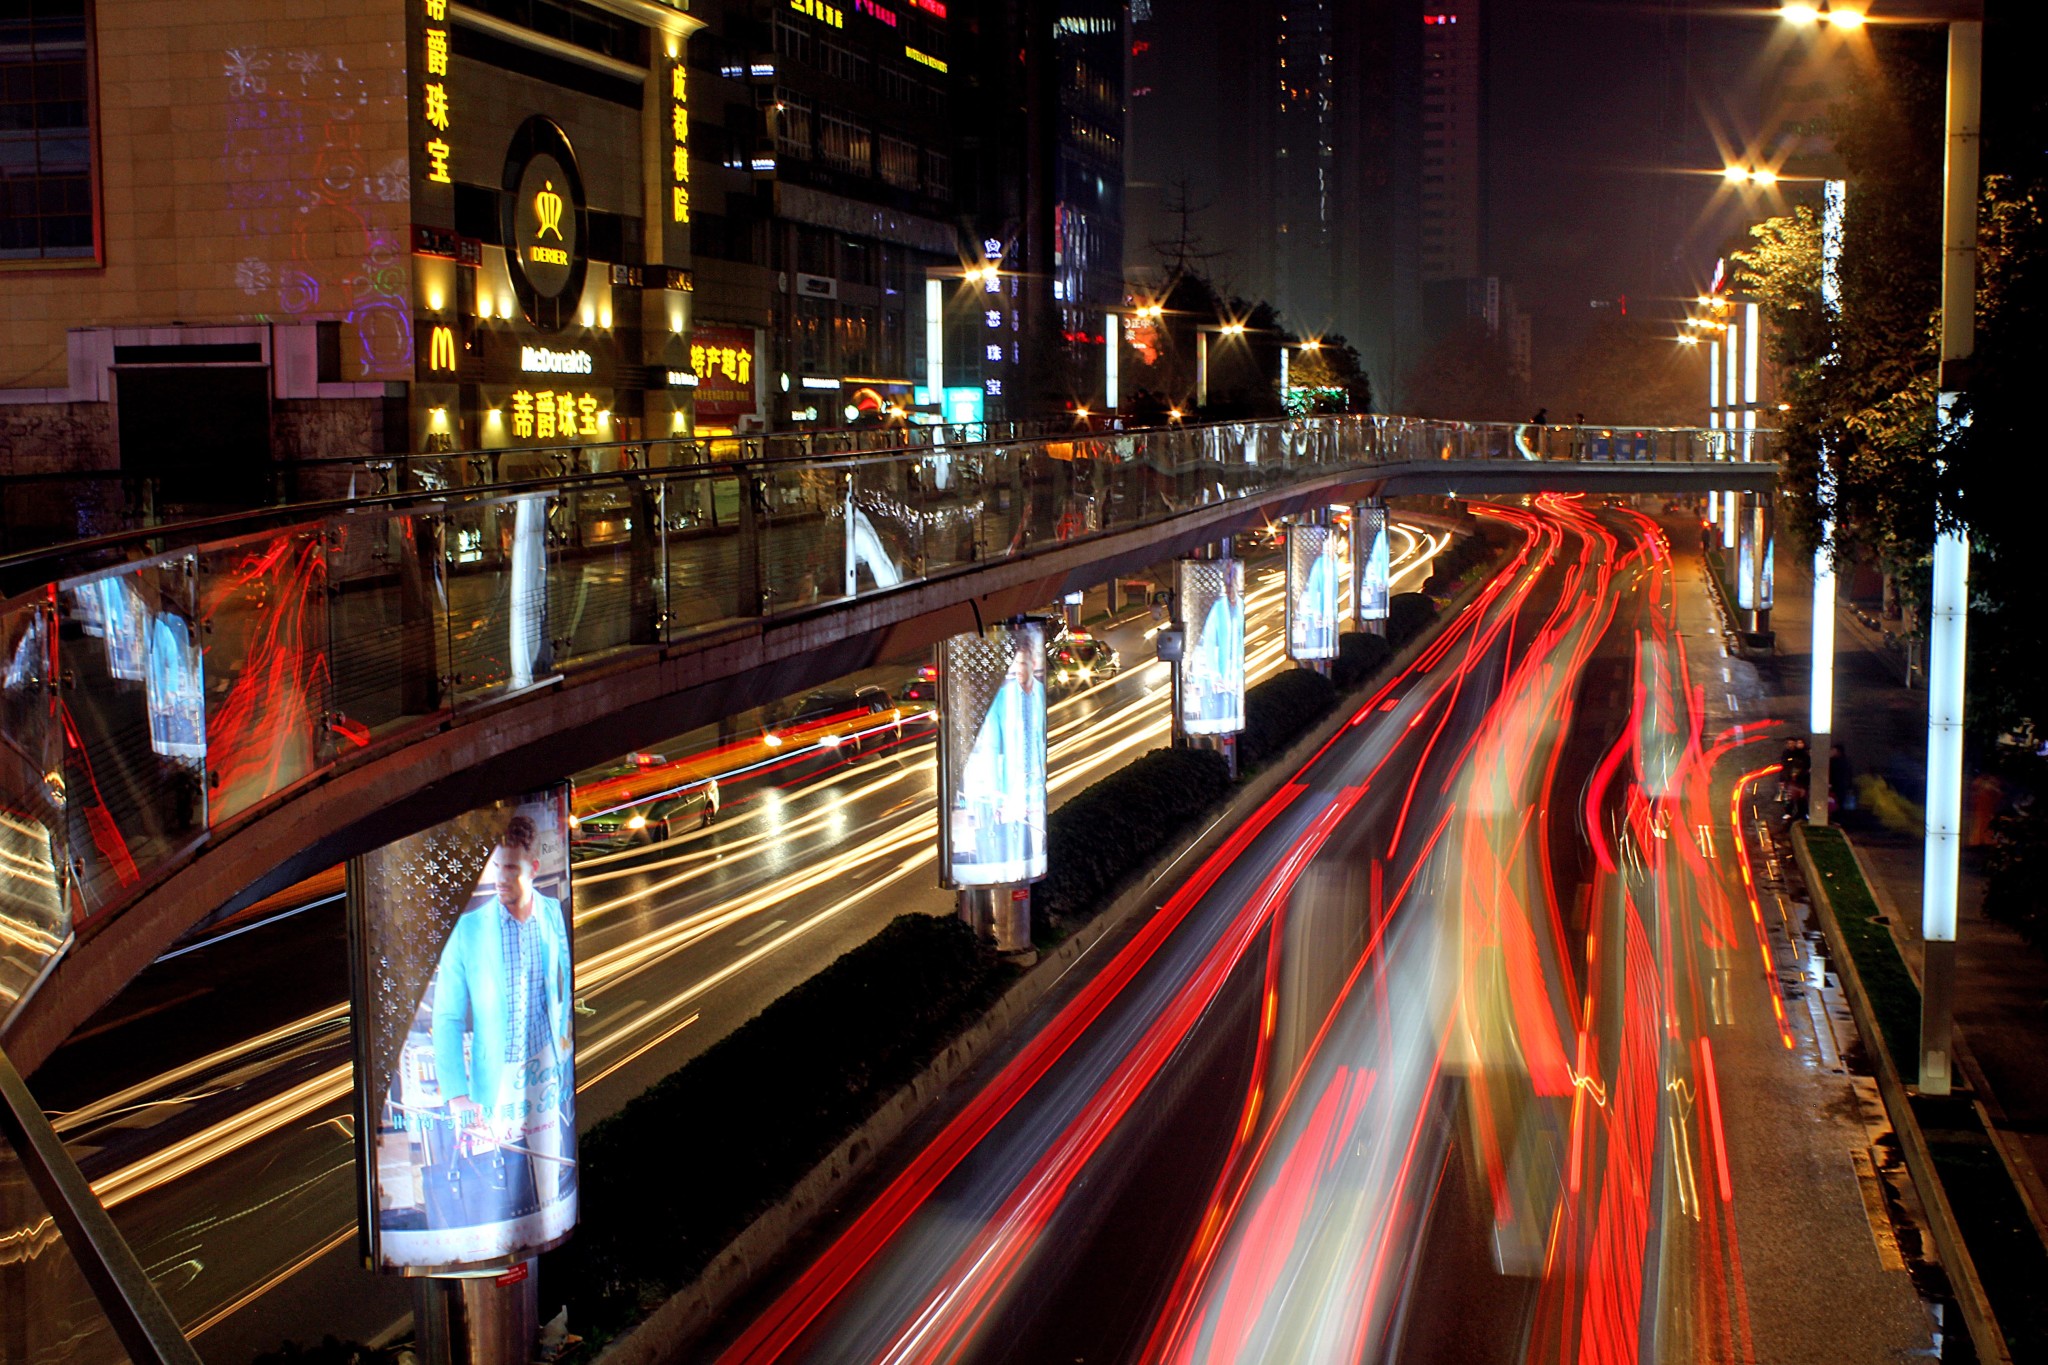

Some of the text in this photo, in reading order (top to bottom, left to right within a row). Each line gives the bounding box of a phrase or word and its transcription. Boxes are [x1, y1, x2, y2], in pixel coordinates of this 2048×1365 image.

[521, 346, 592, 374] McDonald's
[512, 389, 598, 439] 蒂爵珠宝
